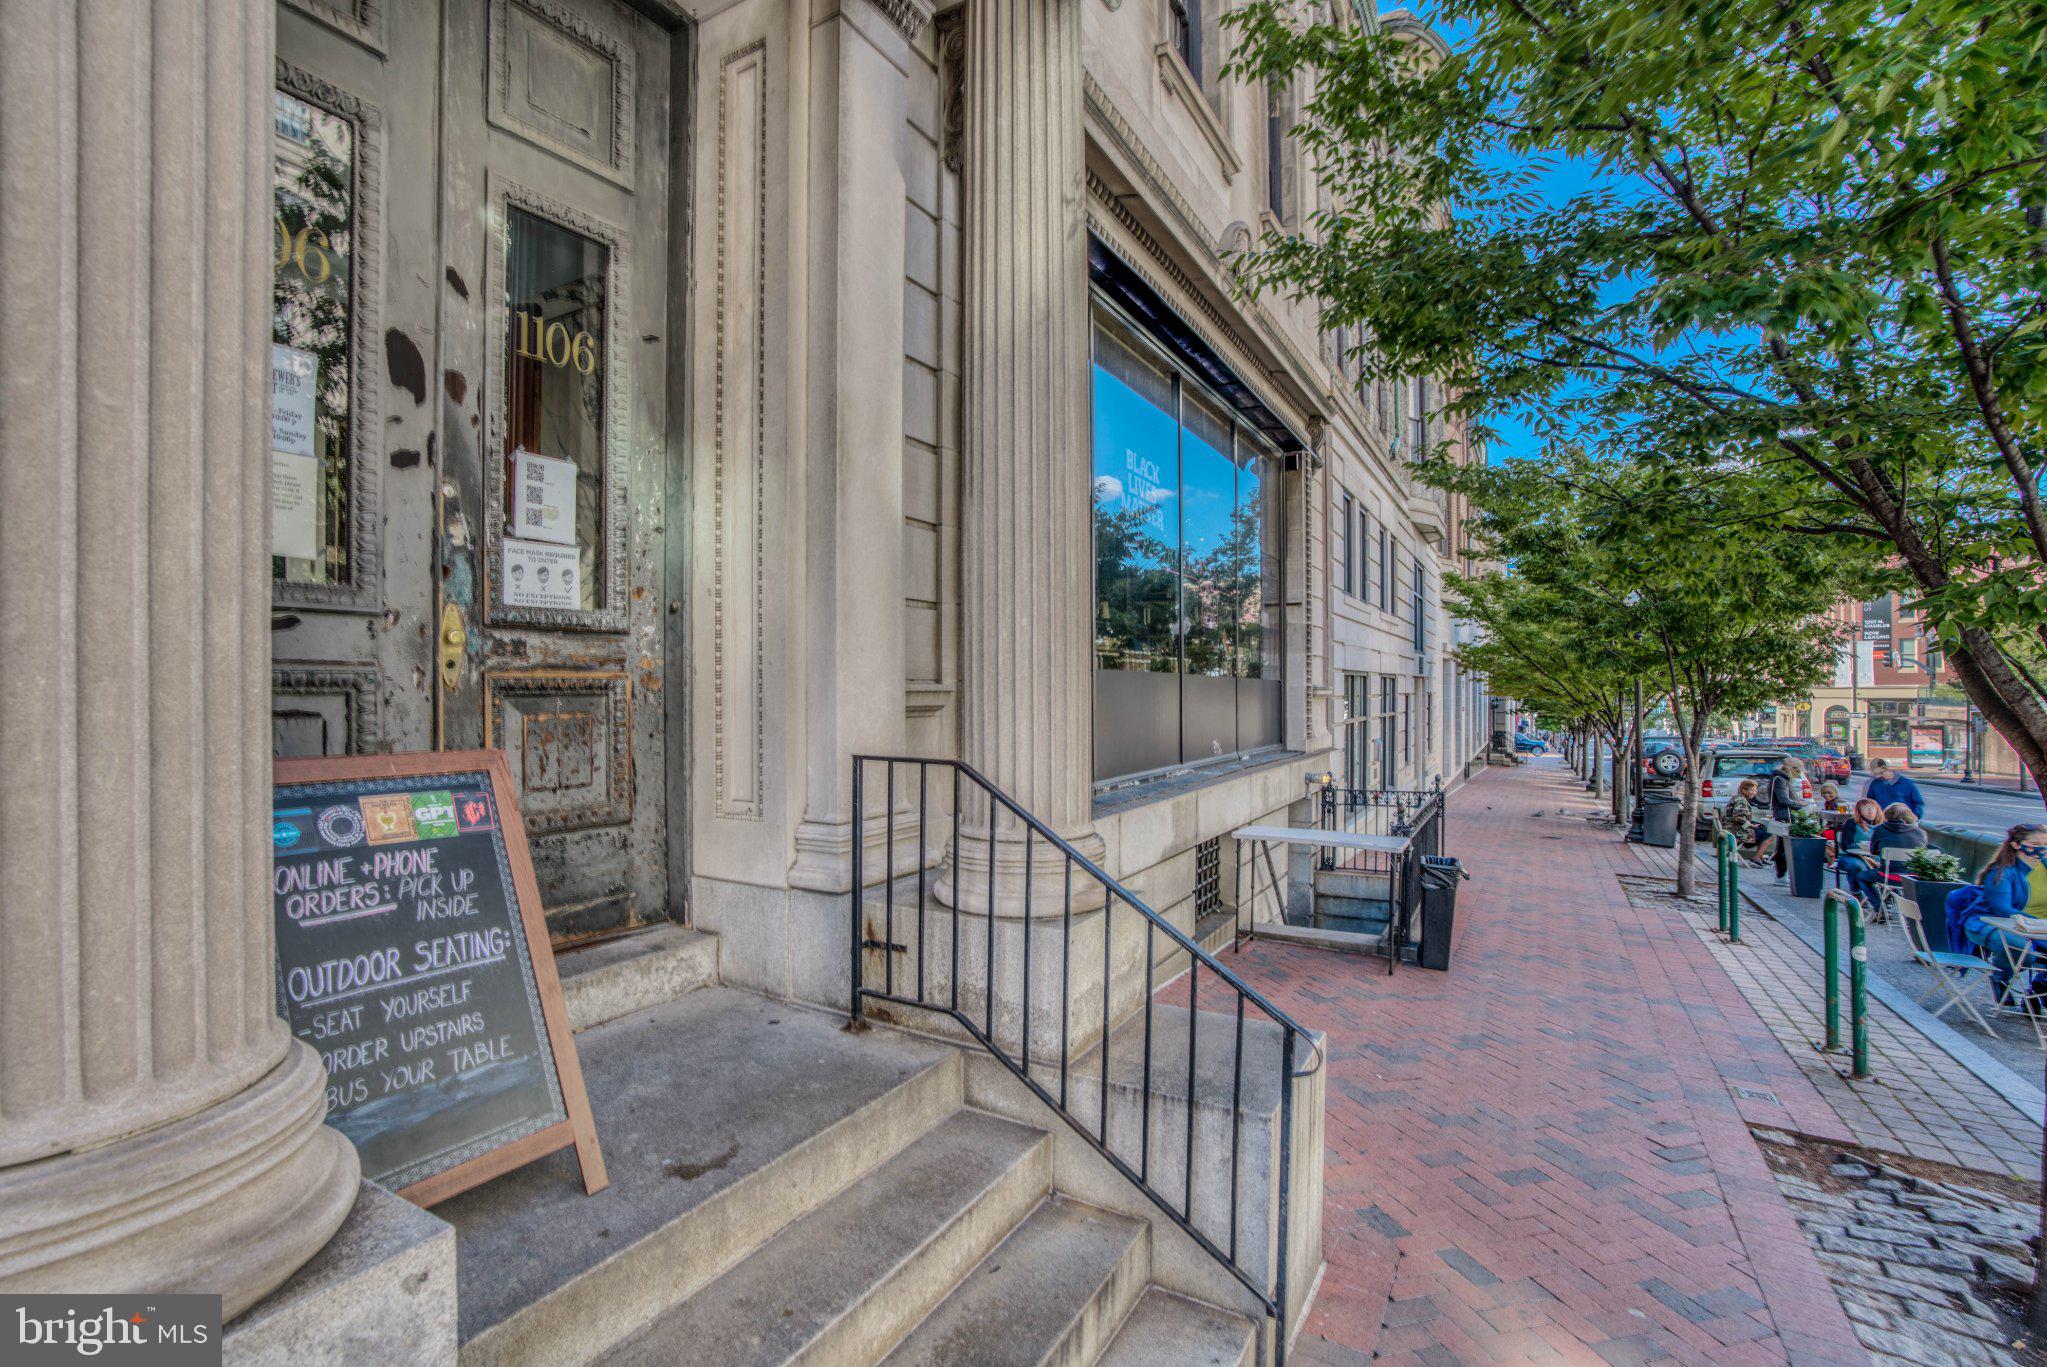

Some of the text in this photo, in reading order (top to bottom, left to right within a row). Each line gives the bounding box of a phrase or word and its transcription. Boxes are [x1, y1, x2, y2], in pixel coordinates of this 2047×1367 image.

[513, 310, 595, 376] 1106
[1126, 449, 1160, 485] BLACK
[1128, 471, 1157, 504] LIVES
[1121, 491, 1164, 531] MAER
[545, 551, 576, 560] REQUIRED
[273, 857, 355, 895] ONLINE
[285, 868, 475, 920] ORDERS: PICK UP
[416, 893, 480, 922] INSIDE
[287, 926, 511, 1002] OUTDOOR SEATING:
[380, 981, 473, 1023] YOURSELF
[400, 1012, 486, 1052] UPSTAIRS
[325, 1034, 514, 1112] BUS YOUR TABLE
